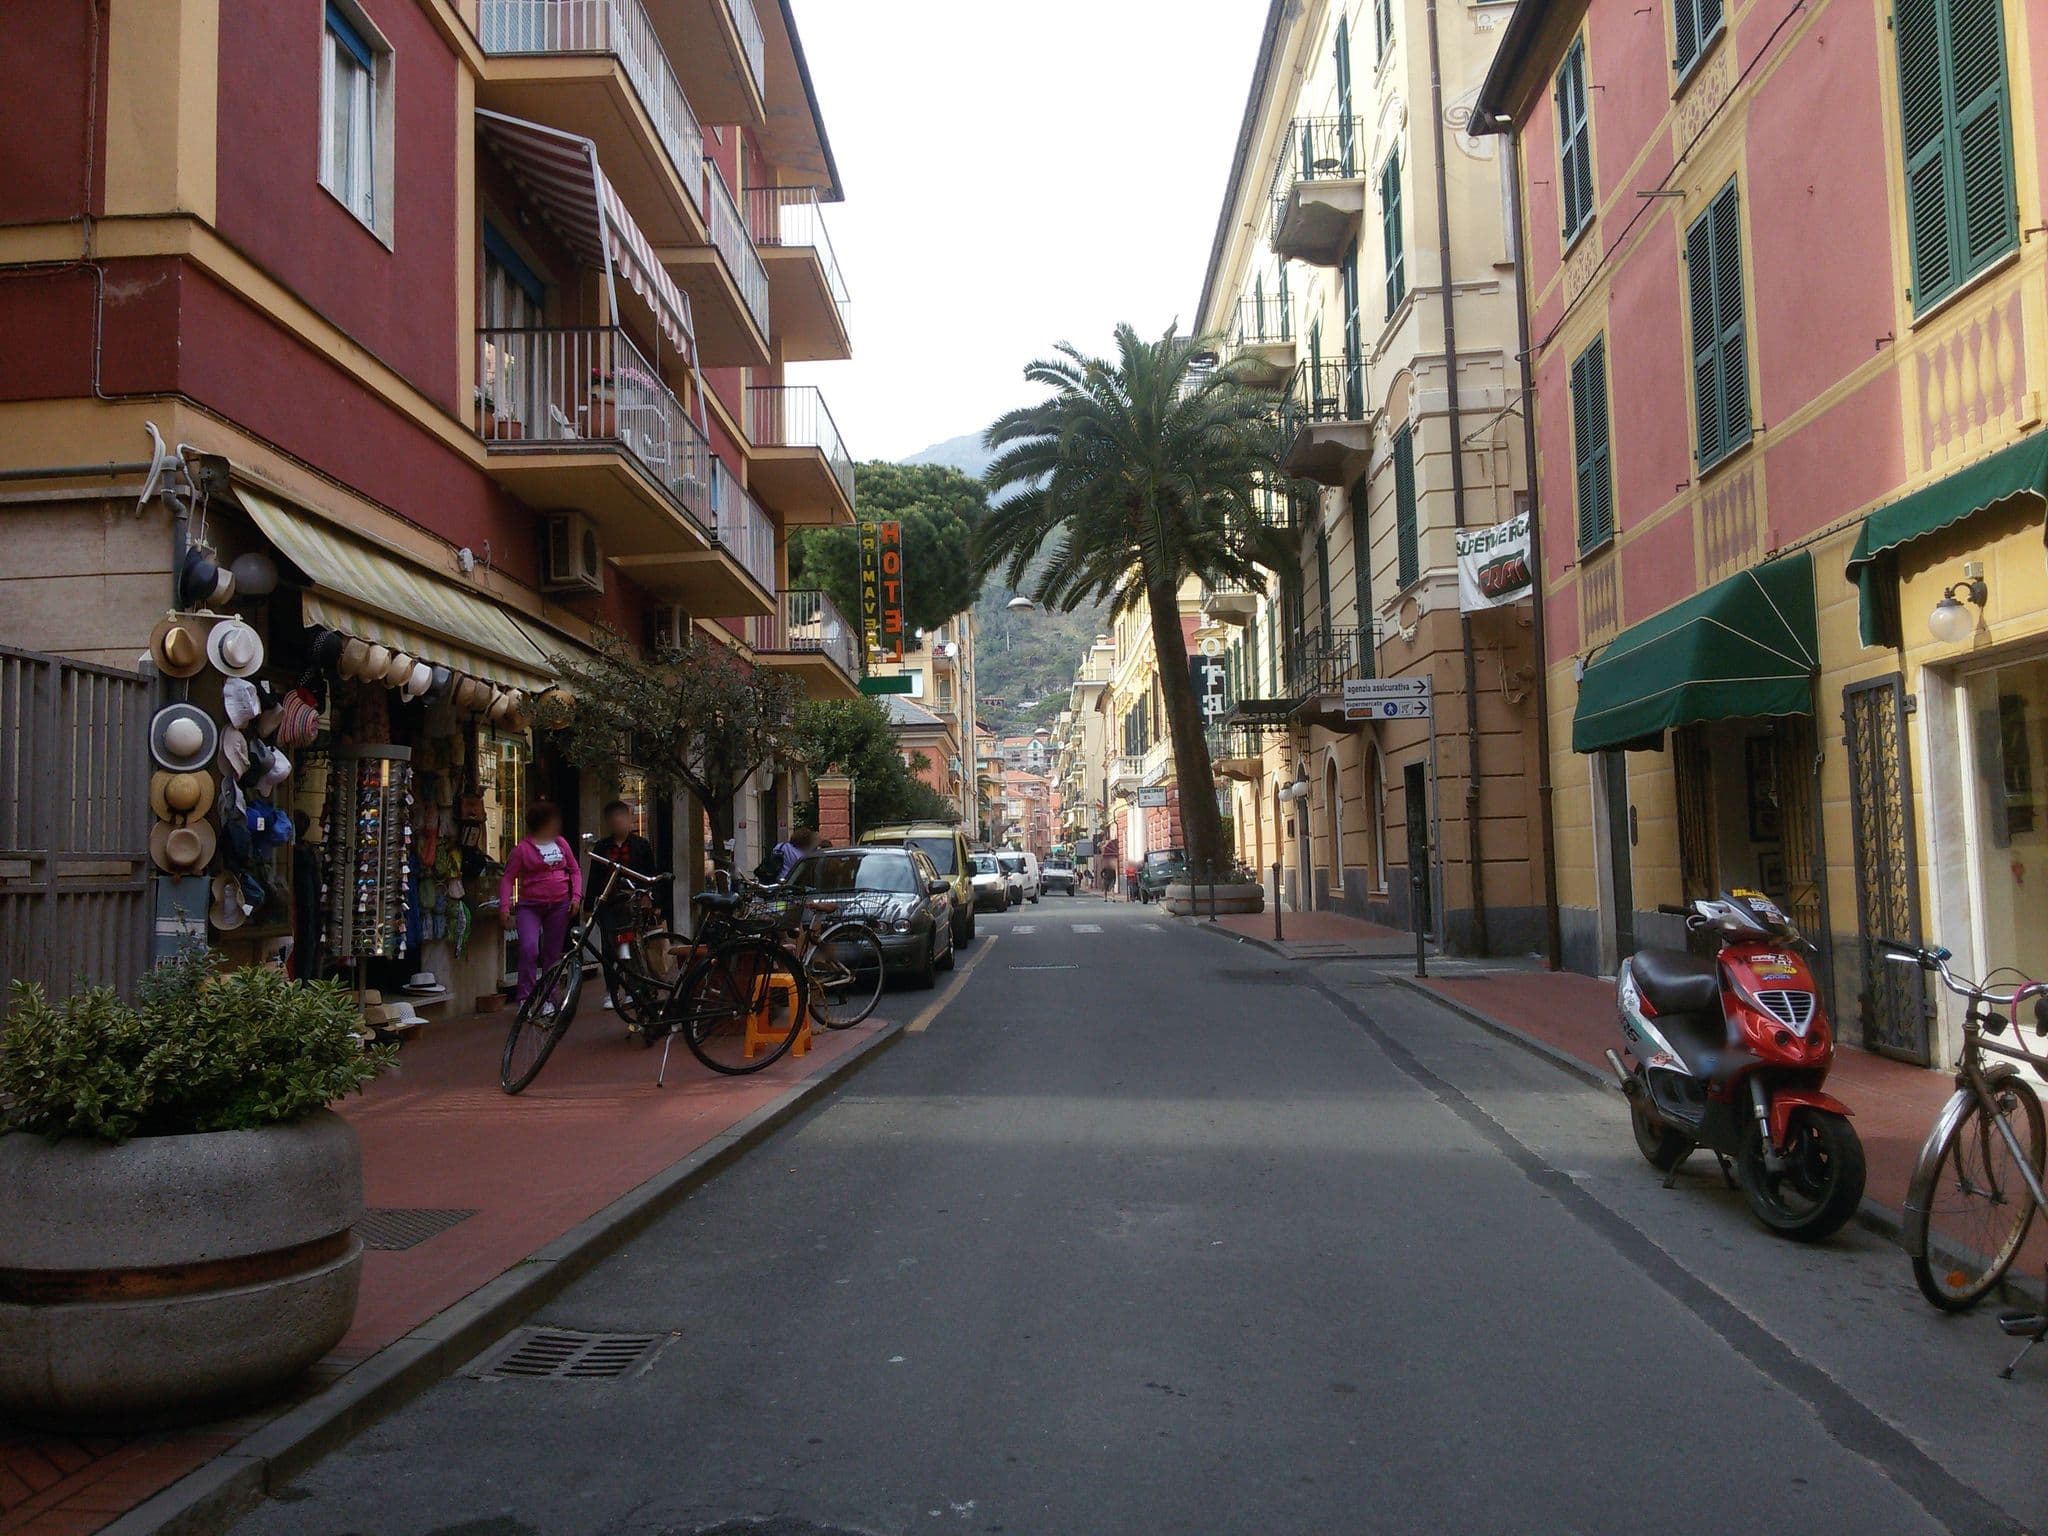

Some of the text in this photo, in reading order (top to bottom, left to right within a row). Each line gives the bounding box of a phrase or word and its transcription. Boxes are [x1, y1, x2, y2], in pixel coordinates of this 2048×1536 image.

[1479, 556, 1524, 597] CRAI
[1347, 683, 1410, 694] agenzia assicurativa
